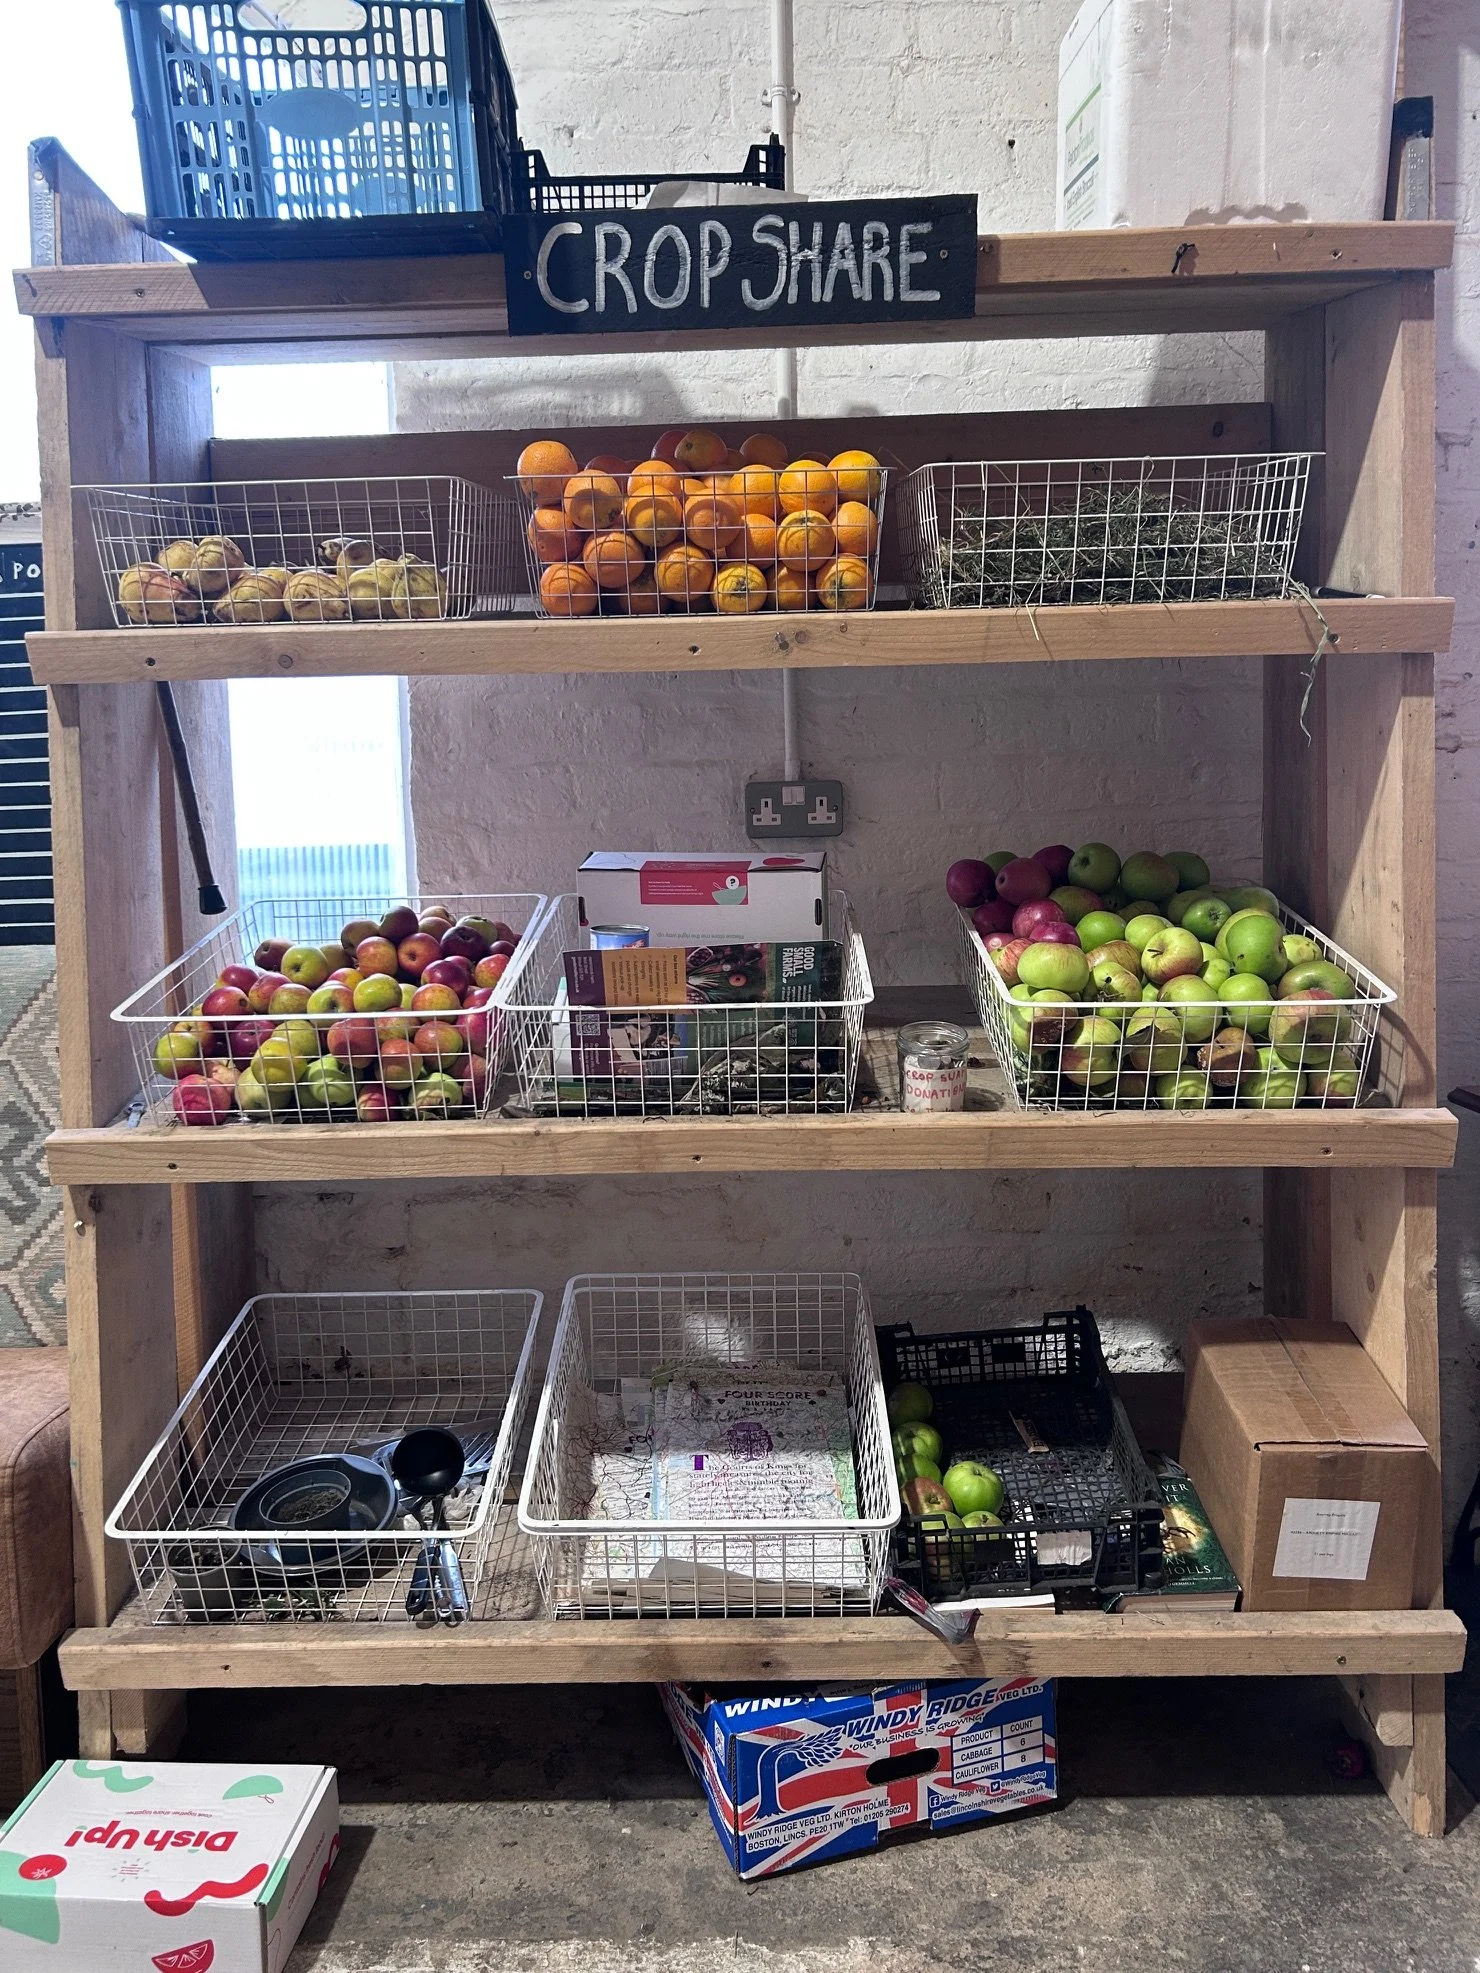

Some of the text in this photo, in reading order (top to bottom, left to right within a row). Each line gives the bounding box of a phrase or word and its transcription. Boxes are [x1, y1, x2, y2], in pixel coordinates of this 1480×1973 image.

[537, 213, 942, 314] CROP SHARE
[793, 947, 804, 977] SMALL
[803, 946, 815, 970] GOOD
[906, 1070, 934, 1083] CROP
[906, 1083, 967, 1099] DONATION
[724, 1390, 812, 1400] FOUR SCORE
[1161, 1483, 1189, 1492] VER
[1165, 1494, 1179, 1502] IT
[1165, 1565, 1211, 1574] HOLLS
[1166, 1557, 1187, 1565] AN
[725, 1697, 816, 1718] WIND
[847, 1684, 1043, 1738] WINDY RIDGE VEG LTD.
[1010, 1719, 1034, 1732] COUNT
[874, 1728, 924, 1746] BUSINESS
[926, 1724, 935, 1733] IS
[961, 1730, 994, 1745] PRODUCT
[1020, 1738, 1026, 1746] 6
[960, 1746, 993, 1762] CABBAGE
[1020, 1754, 1026, 1763] 8
[955, 1761, 999, 1780] CAULIFLOWER
[1001, 1770, 1046, 1788] @WindyRidgeVeg
[933, 1785, 1045, 1819] sales@lincolnshirevegetables.co.uk
[941, 1786, 987, 1803] Windy Ridge Veg
[747, 1828, 772, 1841] WINDY
[774, 1823, 798, 1835] RIDGE
[800, 1818, 815, 1828] VEG
[834, 1806, 862, 1819] KIRTON
[863, 1798, 889, 1812] HOLME
[748, 1837, 782, 1851] BOSTON,
[809, 1825, 828, 1836] PE20
[829, 1821, 845, 1832] 1TW
[850, 1816, 863, 1826] Tel:
[863, 1812, 884, 1823] 01205
[885, 1804, 910, 1817] 290274
[64, 1819, 239, 1853] Dish Up!
